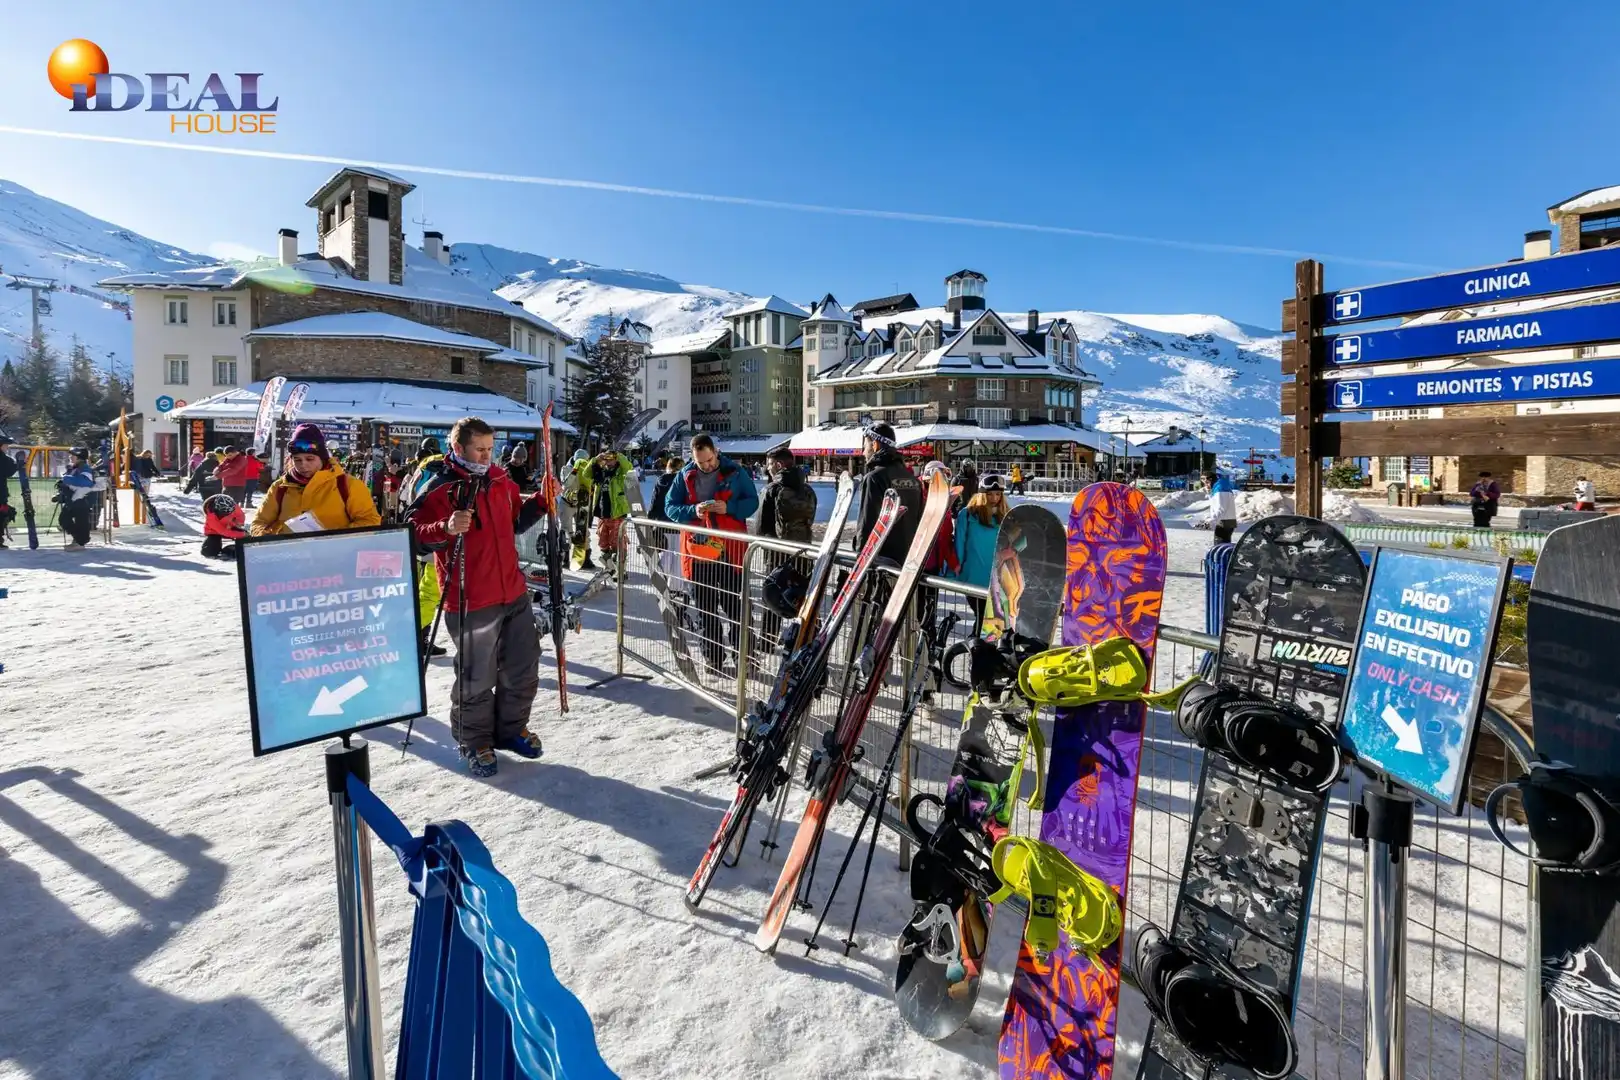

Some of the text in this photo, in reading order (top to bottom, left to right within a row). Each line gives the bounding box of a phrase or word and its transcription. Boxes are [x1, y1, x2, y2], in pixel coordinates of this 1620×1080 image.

[1464, 271, 1531, 296] CLINICA
[1456, 321, 1542, 344] FARMACIA
[1416, 371, 1593, 397] REMONTES Y PISTAS
[389, 426, 422, 435] TALLER
[1401, 588, 1450, 613] PAGO
[1374, 608, 1472, 648] EXCLUSIVO
[1271, 640, 1351, 666] BURTON
[1364, 632, 1474, 679] EN EFECTIVO
[1367, 661, 1461, 707] ONLY CASH
